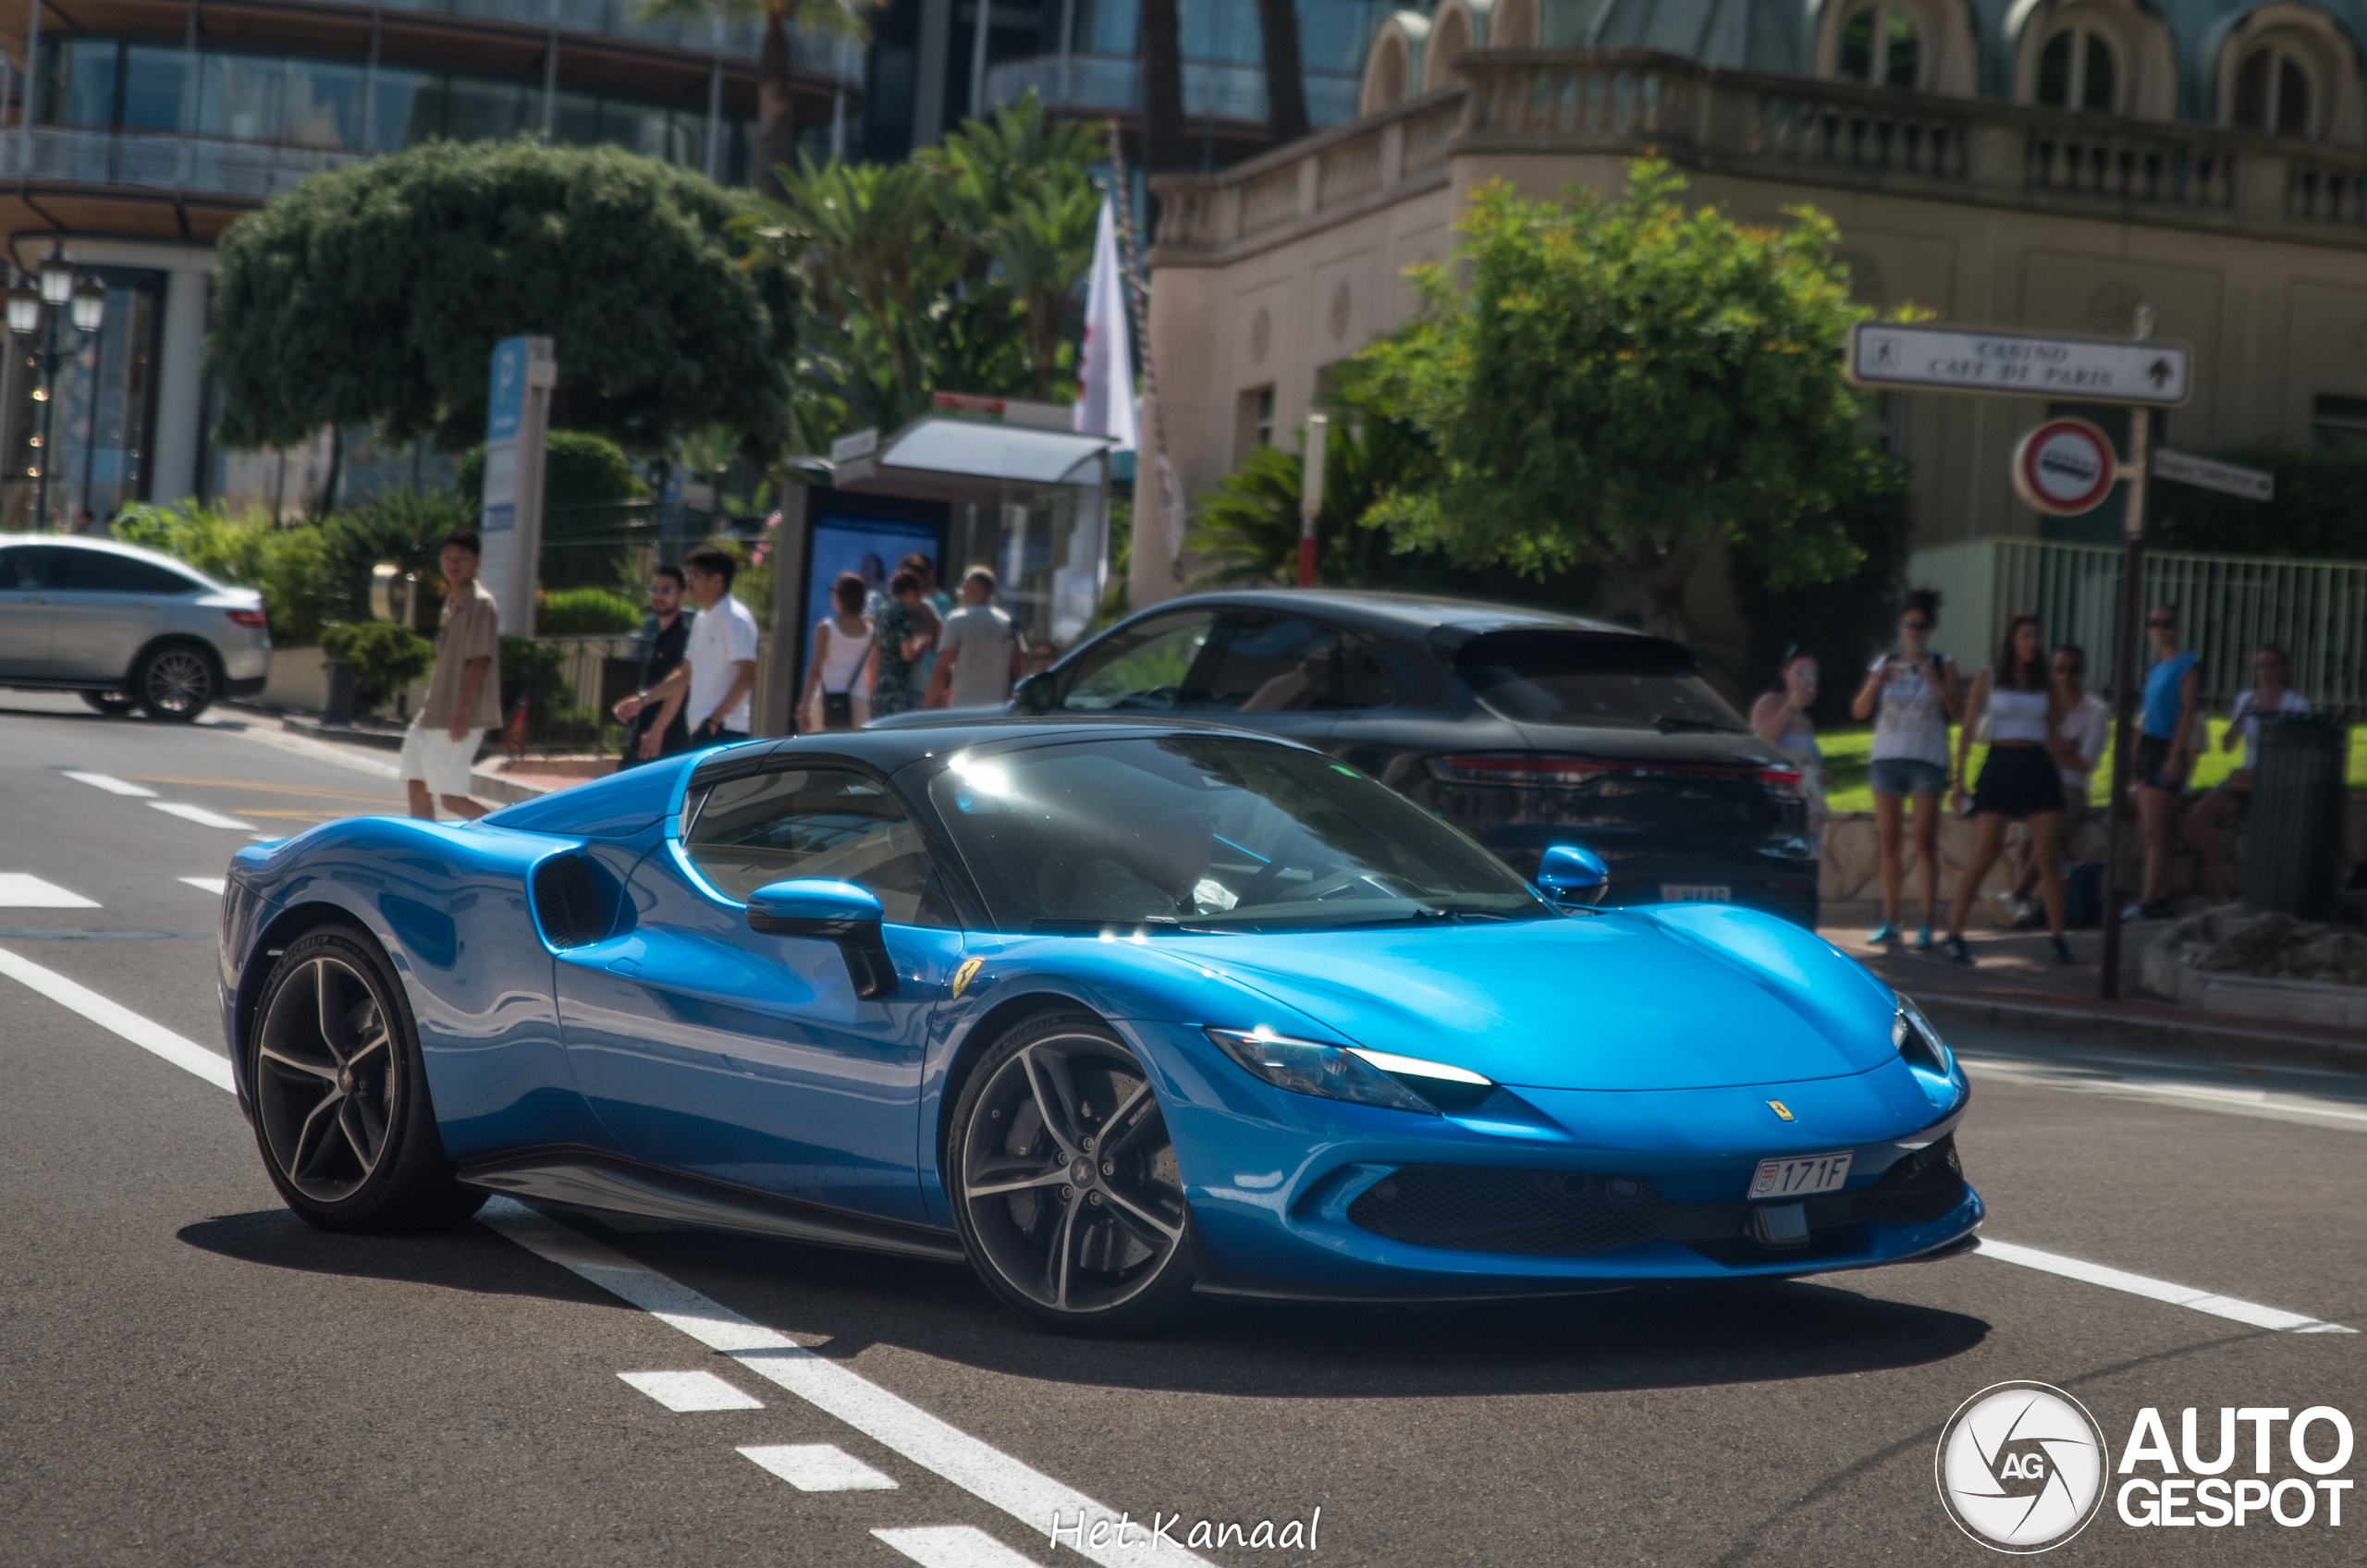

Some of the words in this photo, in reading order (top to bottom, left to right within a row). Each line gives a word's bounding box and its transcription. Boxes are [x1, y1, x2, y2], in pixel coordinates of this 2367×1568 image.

[1975, 342, 2068, 363] CASINO
[497, 351, 515, 405] P
[2000, 363, 2030, 381] DE
[2044, 367, 2113, 387] PARIS
[1759, 1179, 1772, 1189] MC
[1783, 1158, 1847, 1193] 171F
